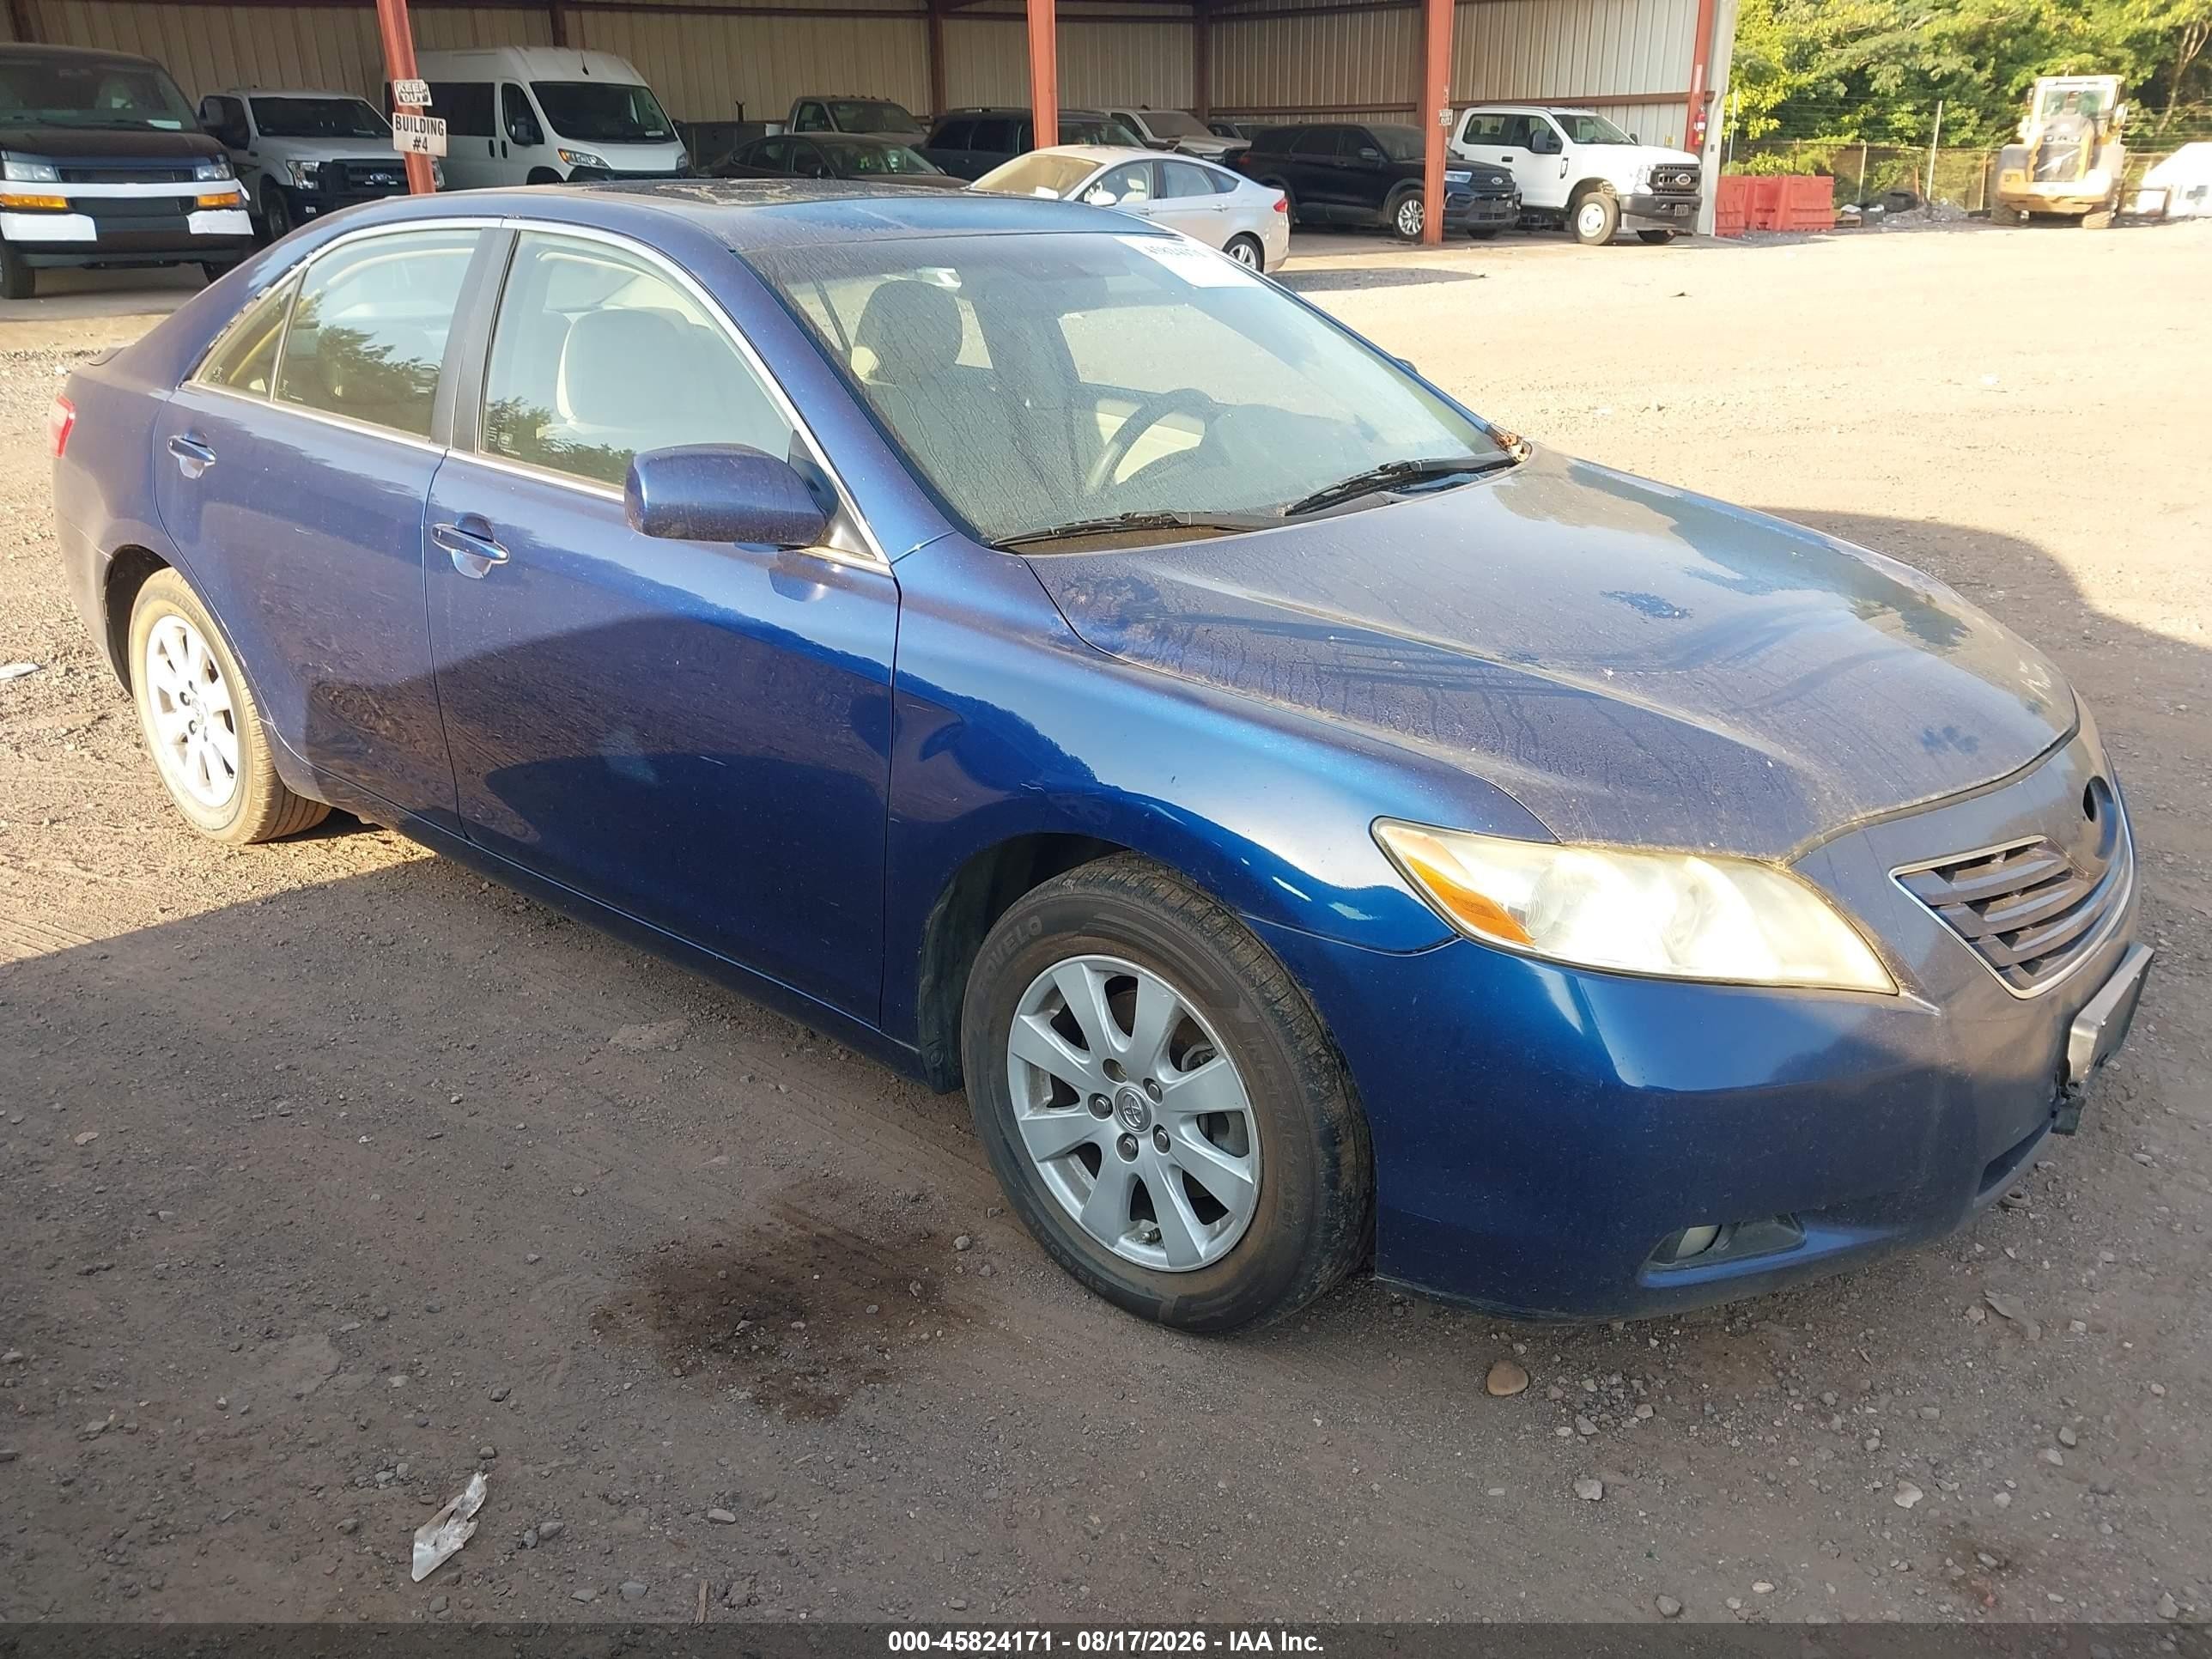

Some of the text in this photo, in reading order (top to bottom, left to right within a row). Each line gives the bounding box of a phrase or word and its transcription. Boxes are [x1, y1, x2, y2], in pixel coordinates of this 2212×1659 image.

[397, 82, 426, 93] KEEP
[402, 92, 424, 102] OUT
[395, 114, 445, 137] BUILDING
[412, 136, 428, 152] #4
[978, 915, 1044, 988] OVELO
